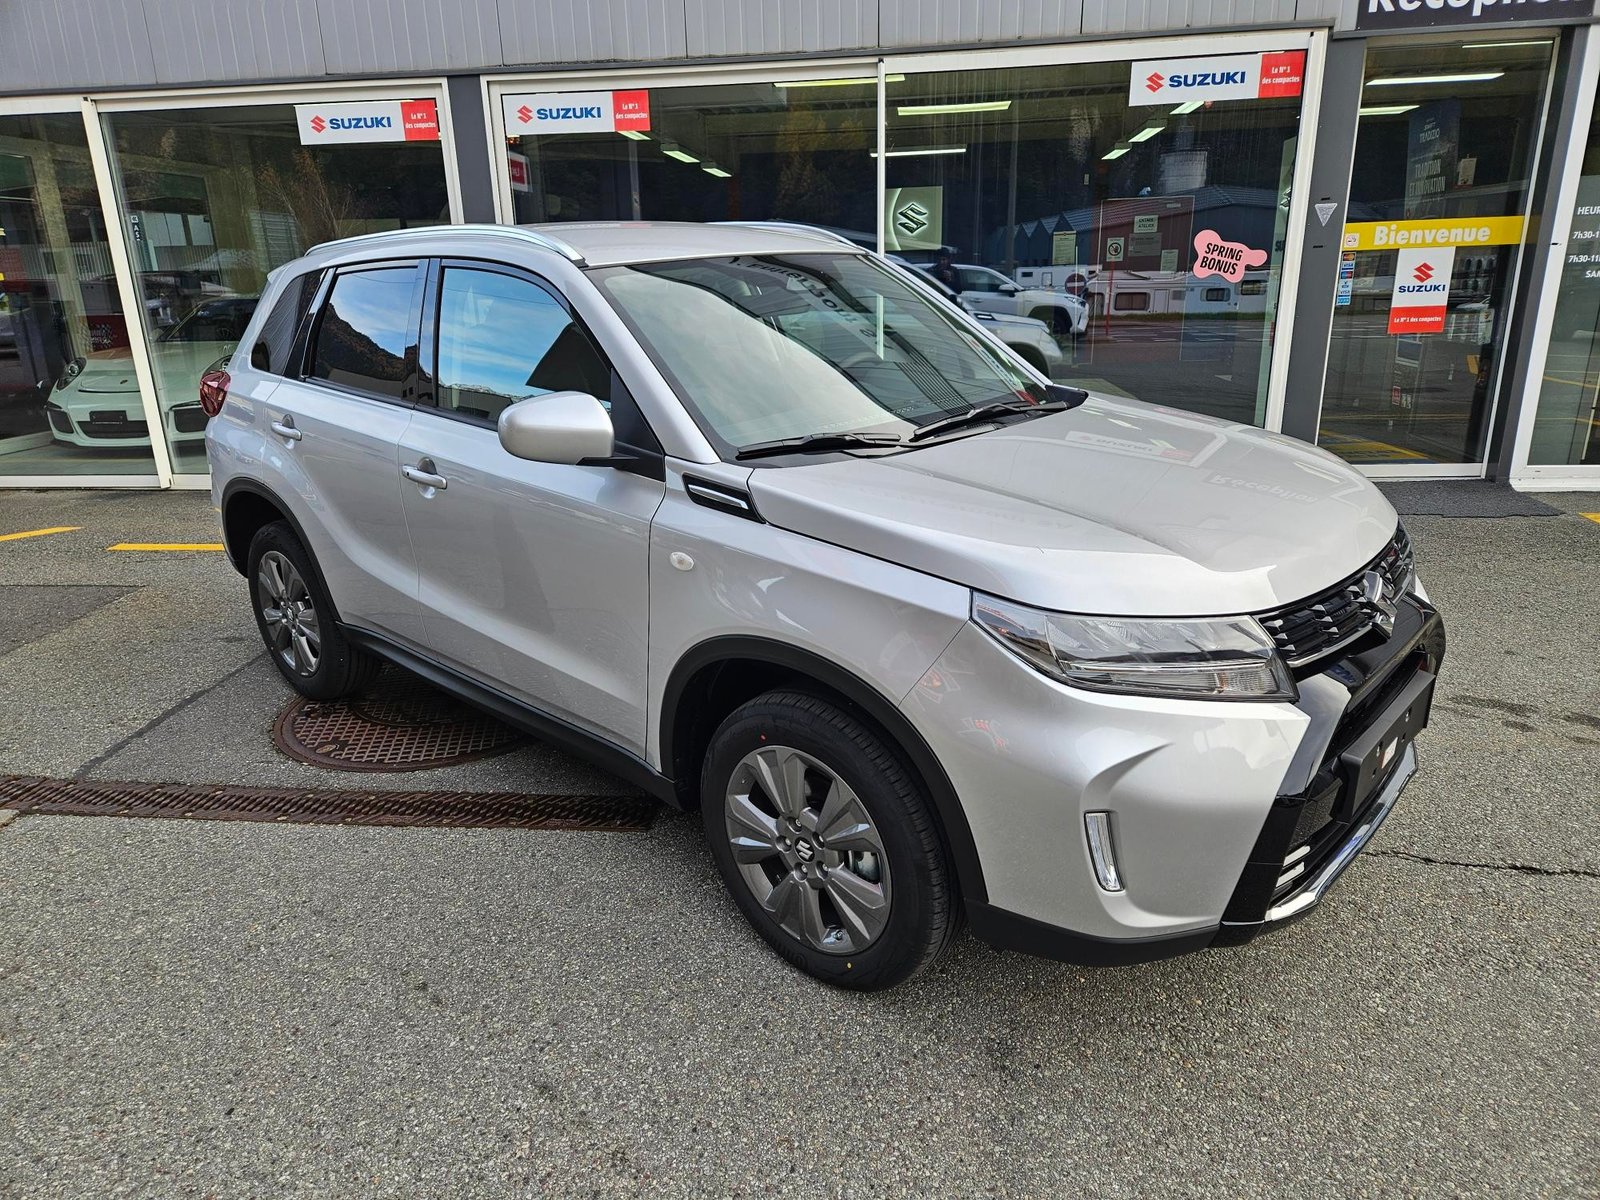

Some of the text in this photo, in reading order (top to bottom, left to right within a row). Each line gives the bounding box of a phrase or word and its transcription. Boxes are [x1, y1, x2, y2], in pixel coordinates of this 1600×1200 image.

[1271, 66, 1278, 74] Le
[1168, 71, 1246, 88] SUZUKI
[1272, 76, 1300, 84] compactes
[536, 106, 602, 120] SUZUKI
[624, 112, 648, 120] compactes
[328, 116, 392, 130] SUZUKI
[413, 121, 437, 129] compactes
[1373, 224, 1491, 245] Bienvenue
[1204, 242, 1244, 262] SPRING
[1199, 255, 1239, 275] BONUS
[1398, 284, 1446, 293] SUZUKI
